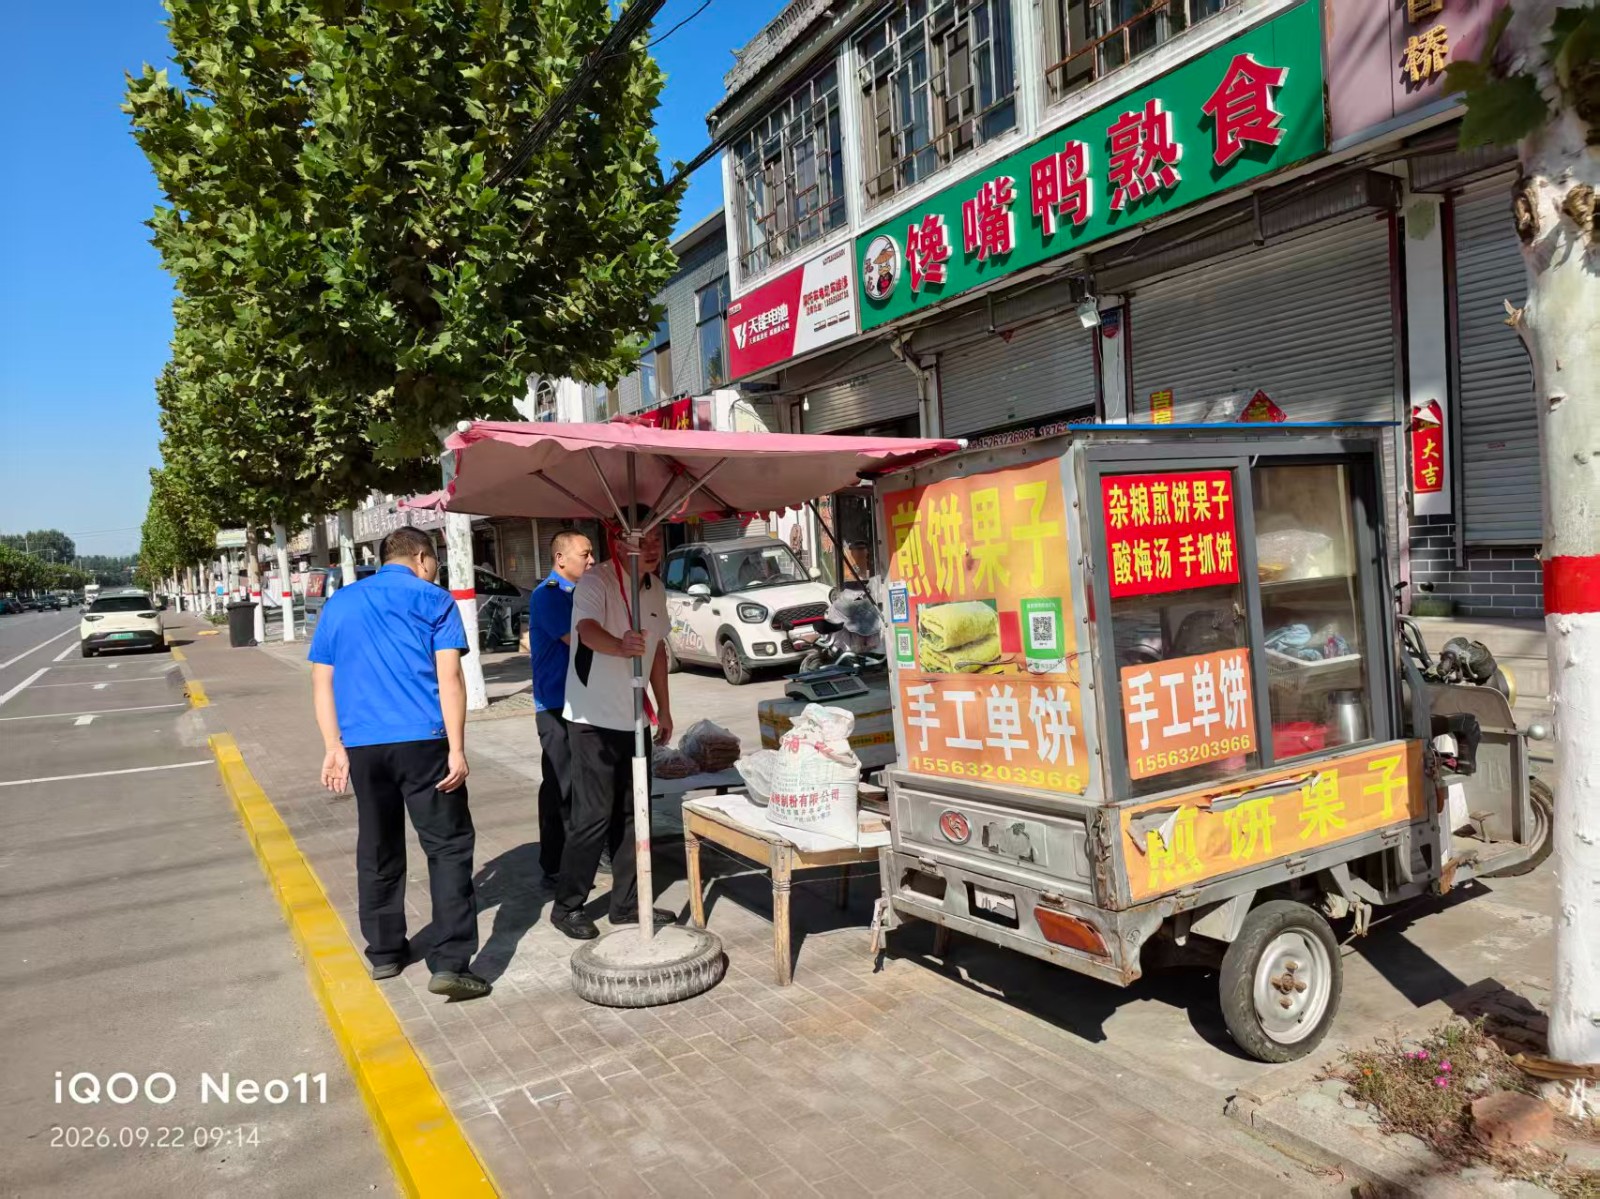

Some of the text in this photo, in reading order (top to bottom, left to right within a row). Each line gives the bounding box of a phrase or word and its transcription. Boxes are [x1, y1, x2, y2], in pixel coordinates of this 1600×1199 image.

[905, 52, 1290, 293] 馋嘴鸭熟食
[747, 302, 788, 336] 天能电池
[1420, 438, 1440, 486] 大吉
[1108, 480, 1230, 530] 杂粮煎饼果子
[892, 480, 1060, 598] 煎饼果子
[1111, 530, 1234, 586] 酸梅汤 手抓饼
[906, 683, 1077, 767] 手工单饼
[1127, 655, 1248, 751] 手工单饼
[911, 756, 1082, 791] 15563203966
[1135, 734, 1251, 774] 15563203966
